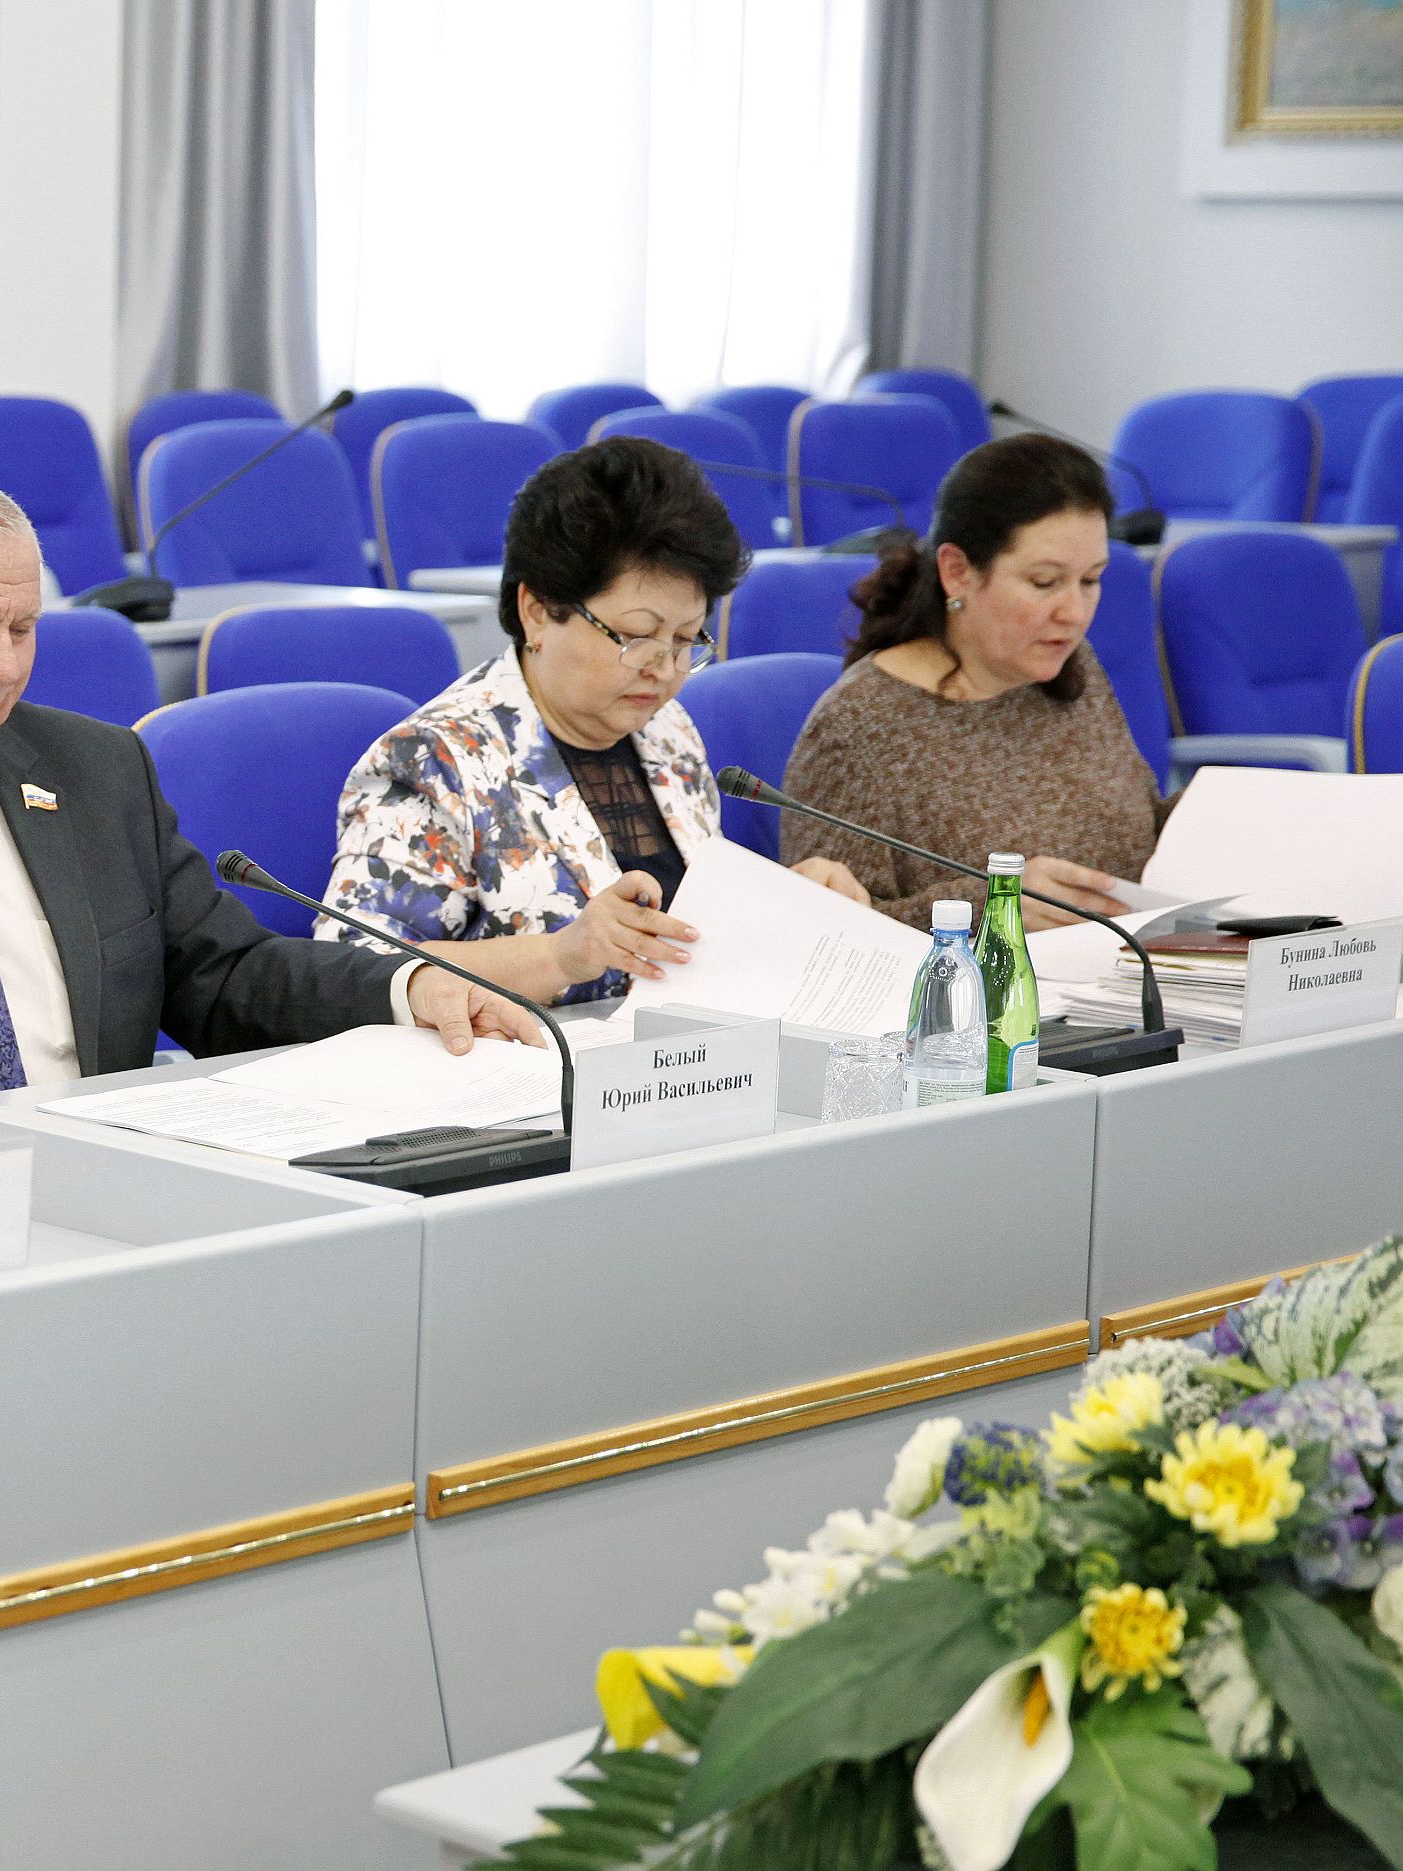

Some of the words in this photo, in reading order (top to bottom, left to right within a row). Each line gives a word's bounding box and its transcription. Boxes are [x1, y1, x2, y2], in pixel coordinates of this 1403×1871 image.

[1280, 947, 1326, 968] Бунина
[1328, 936, 1377, 959] Любовь
[1288, 968, 1363, 992] Николаевна
[653, 1043, 707, 1069] Белый
[601, 1083, 652, 1112] Юрий
[657, 1073, 753, 1101] Васильевич
[489, 1151, 522, 1167] PHILIPS
